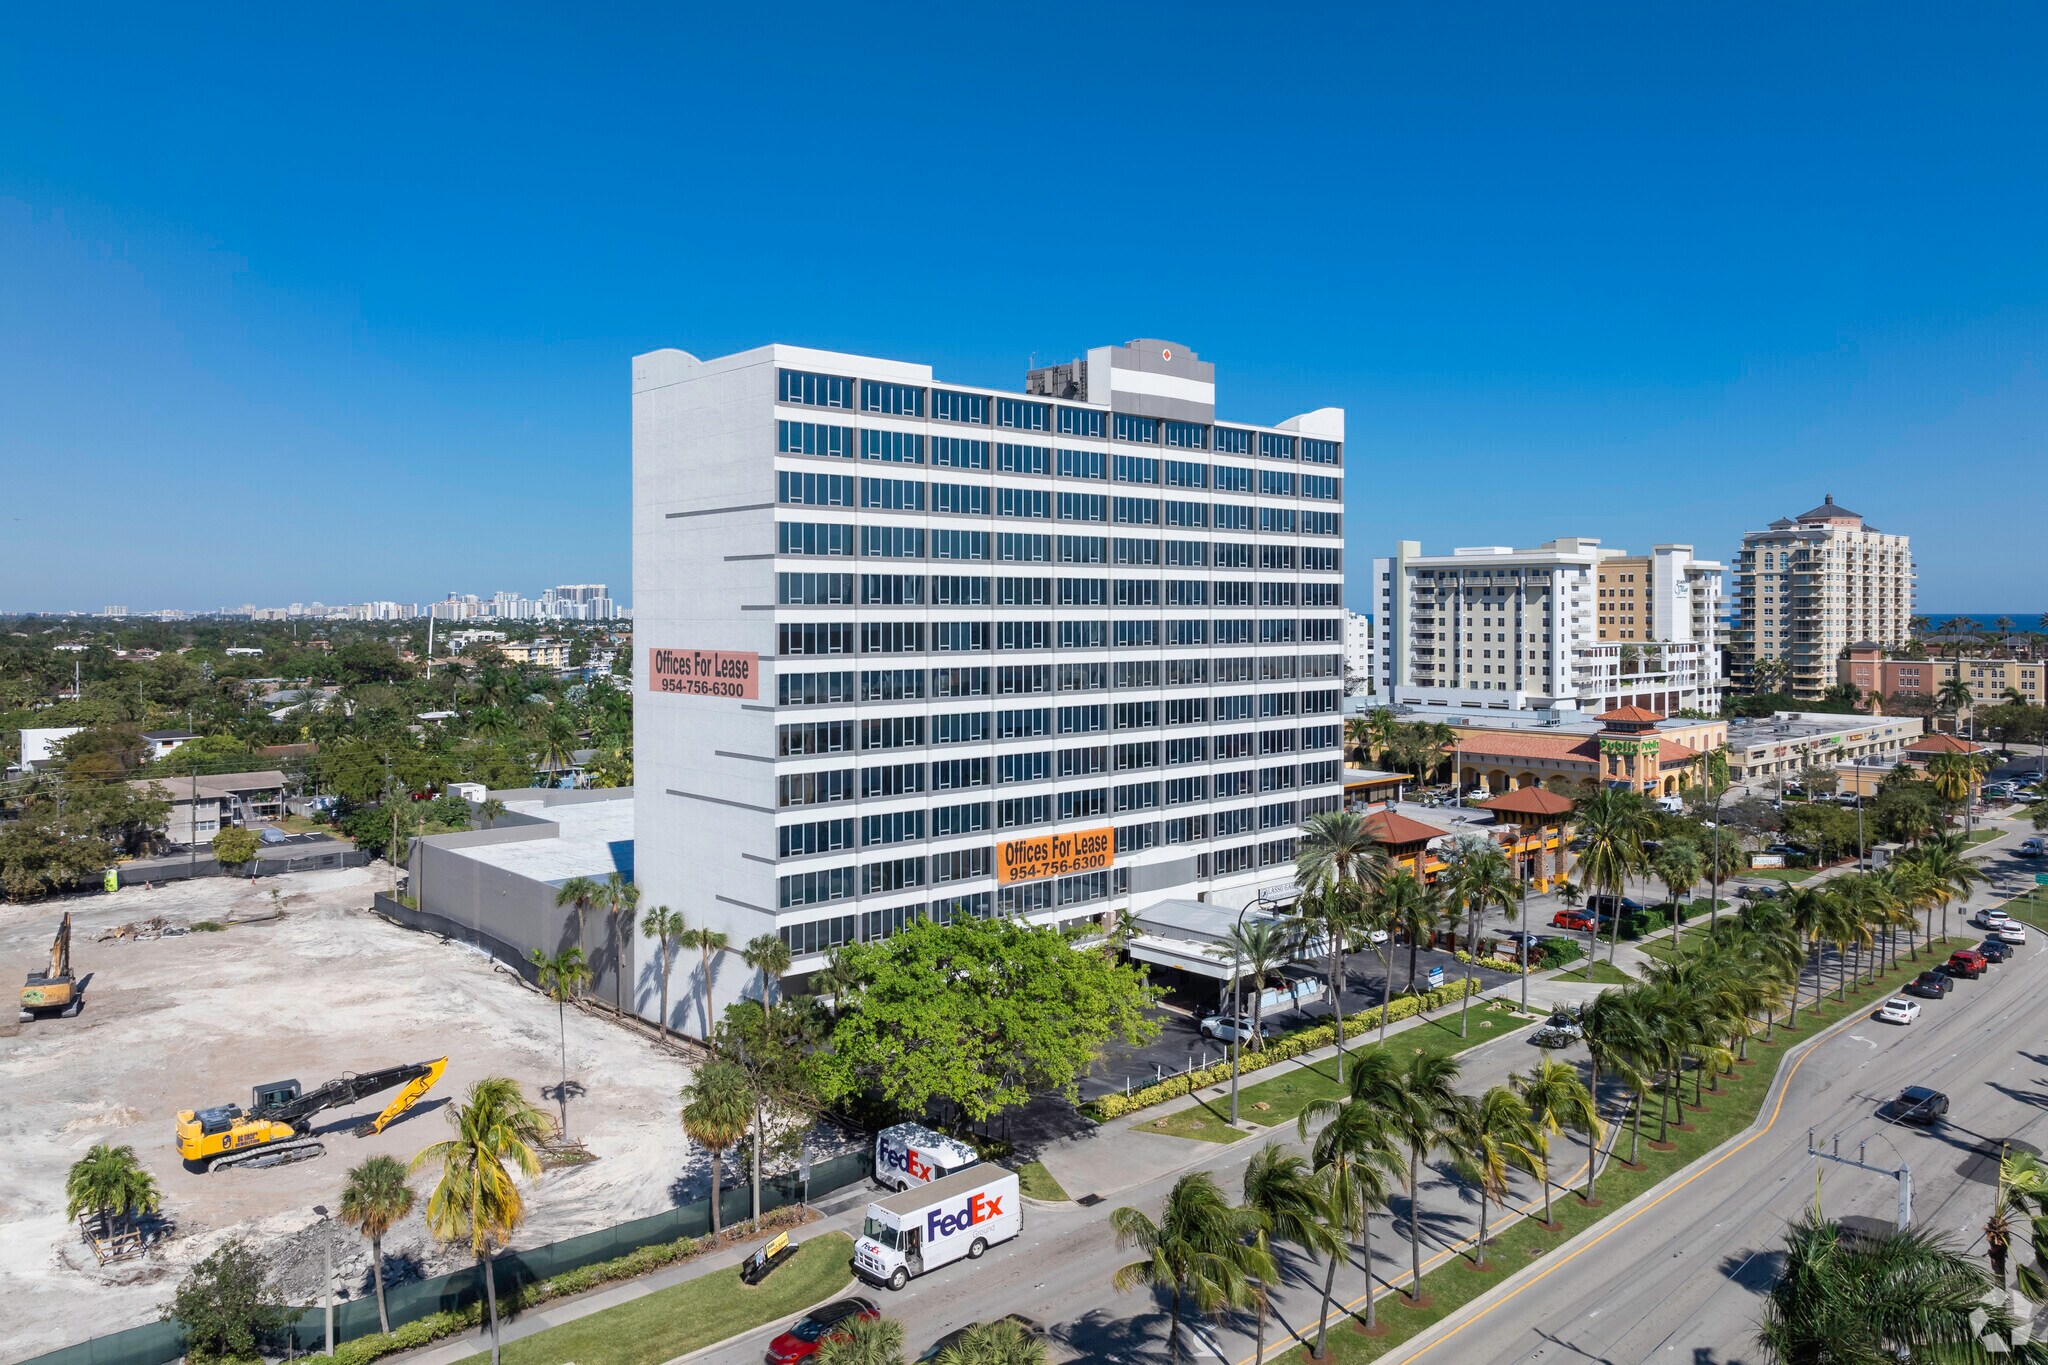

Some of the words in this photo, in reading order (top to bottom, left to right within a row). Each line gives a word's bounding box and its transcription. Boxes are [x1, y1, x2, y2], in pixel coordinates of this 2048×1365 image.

[656, 650, 691, 676] Offices
[694, 652, 712, 677] For
[715, 653, 749, 679] Lease
[662, 679, 744, 697] 954-756-6300
[1600, 739, 1639, 752] Publix
[1005, 841, 1049, 866] Offices
[1052, 836, 1071, 859] For
[1074, 833, 1108, 856] Lease
[1009, 854, 1106, 881] 954-756-6300
[880, 1137, 931, 1182] FedEx
[927, 1192, 1004, 1242] FedEx
[972, 1224, 996, 1238] Ground
[861, 1242, 881, 1255] FedEx
